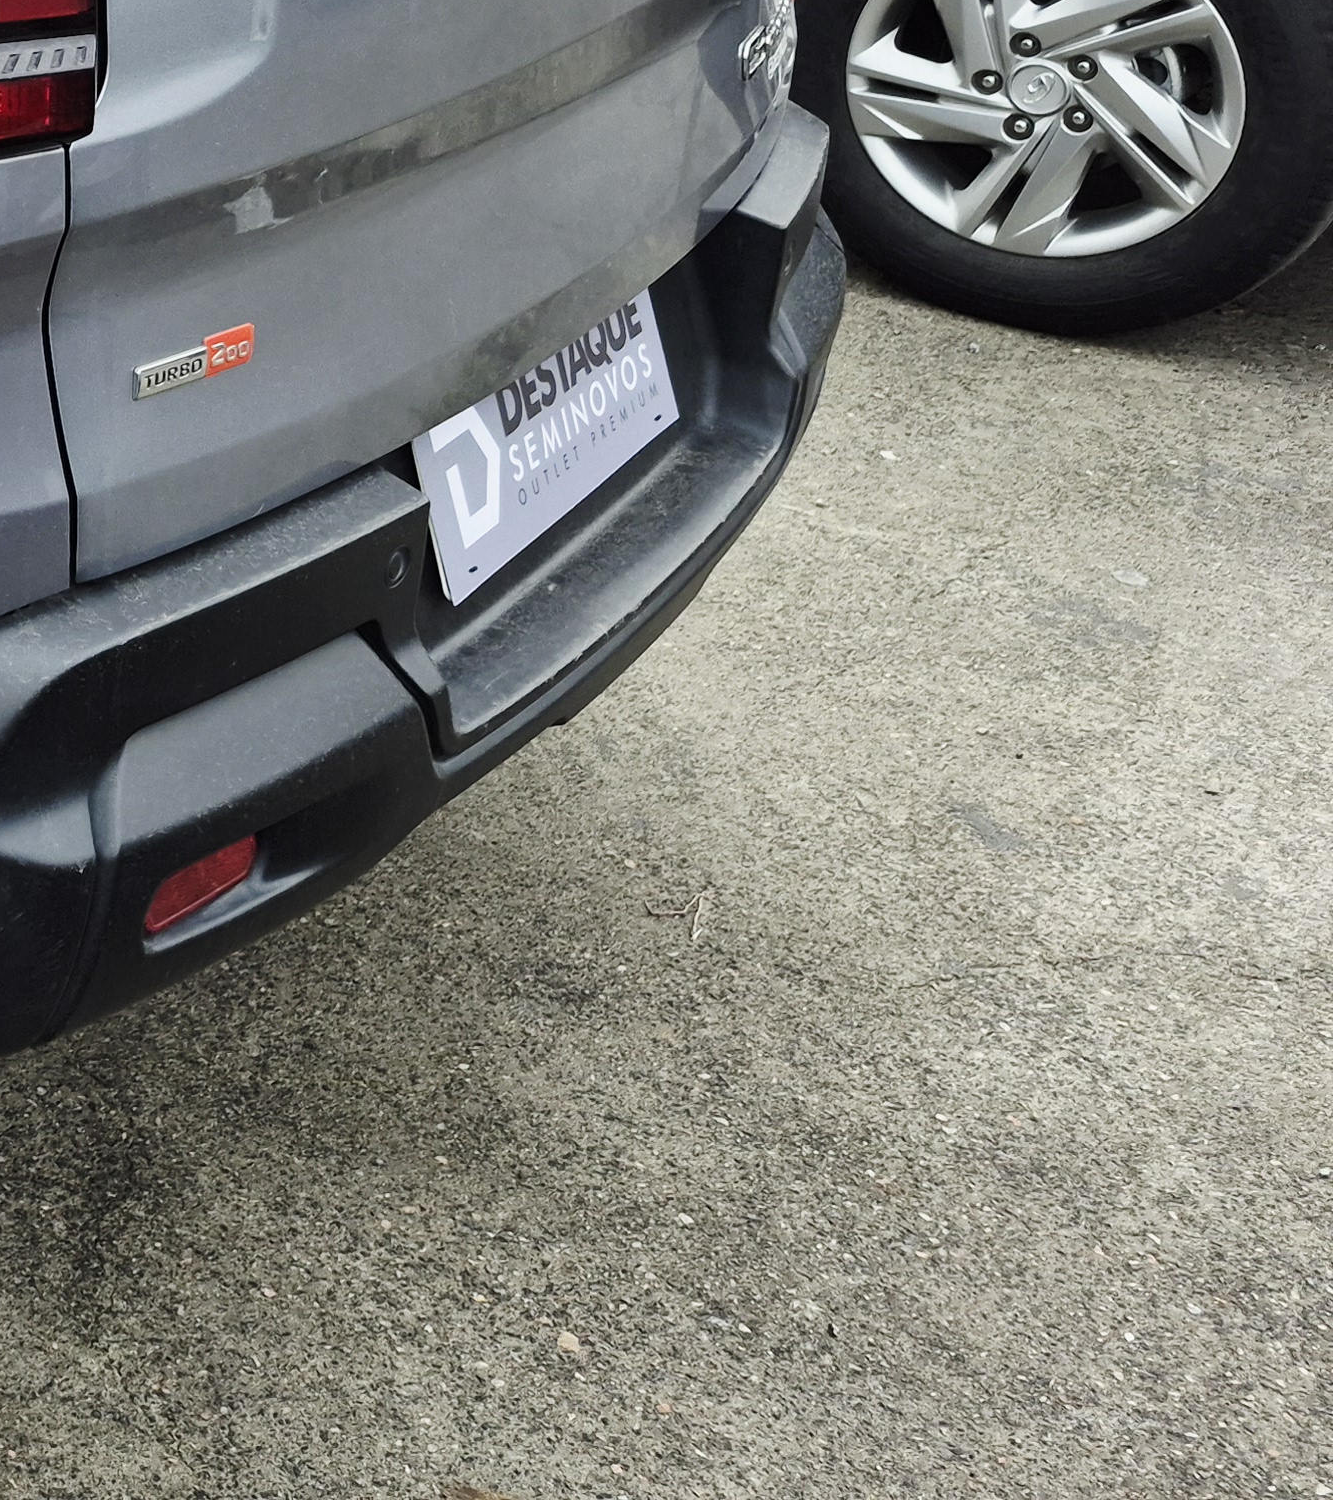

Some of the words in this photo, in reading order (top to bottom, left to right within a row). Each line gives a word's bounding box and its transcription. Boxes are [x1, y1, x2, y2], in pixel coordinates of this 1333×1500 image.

[143, 357, 203, 389] TURBO
[210, 340, 250, 367] 200
[495, 301, 643, 438] DESTAQUE
[508, 343, 652, 482] SEMINOVOS
[517, 445, 580, 506] OUTLET
[590, 381, 659, 448] PREMIUM
